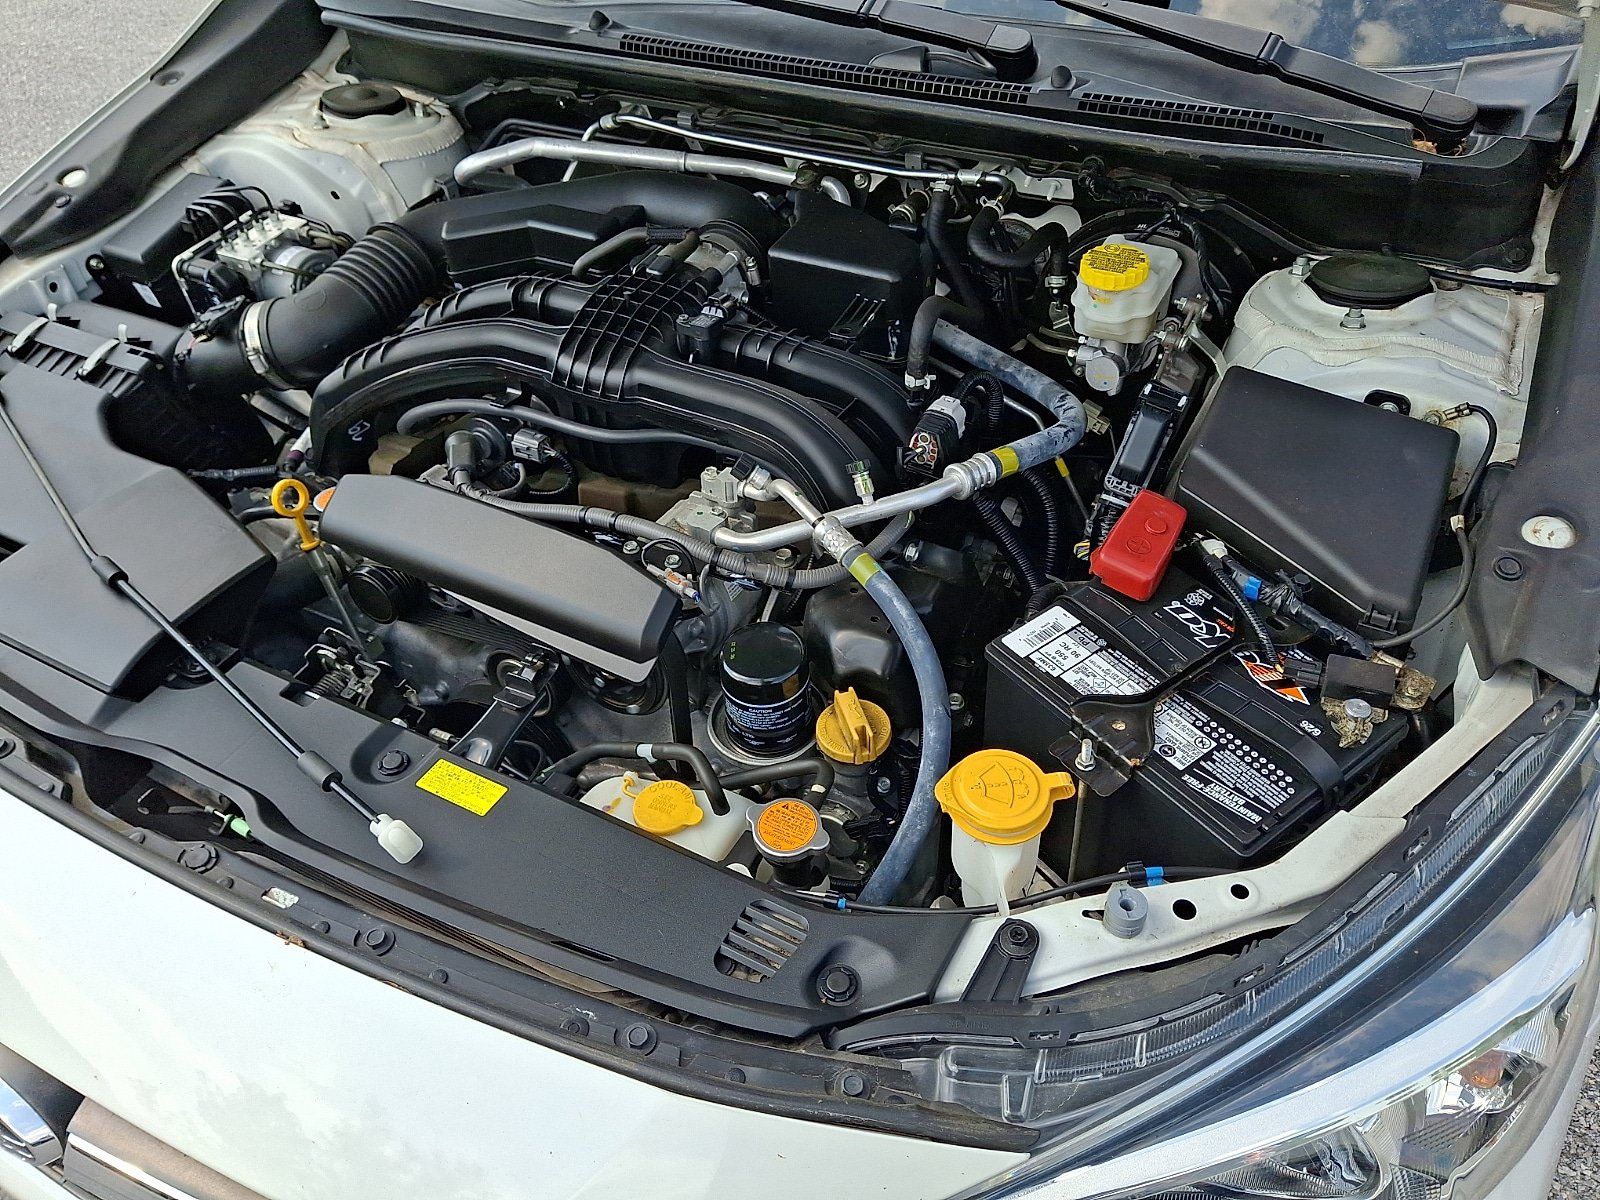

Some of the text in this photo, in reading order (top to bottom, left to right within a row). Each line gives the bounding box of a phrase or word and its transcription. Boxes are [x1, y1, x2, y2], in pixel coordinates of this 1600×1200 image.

[1059, 640, 1081, 657] 90 RC
[1077, 635, 1090, 645] Pb
[1054, 648, 1068, 661] 550
[1298, 719, 1321, 736] 6/26
[649, 781, 694, 805] COOLANT
[1181, 773, 1262, 822] MAINTENANCE-FREE
[1207, 781, 1246, 805] BATTERY
